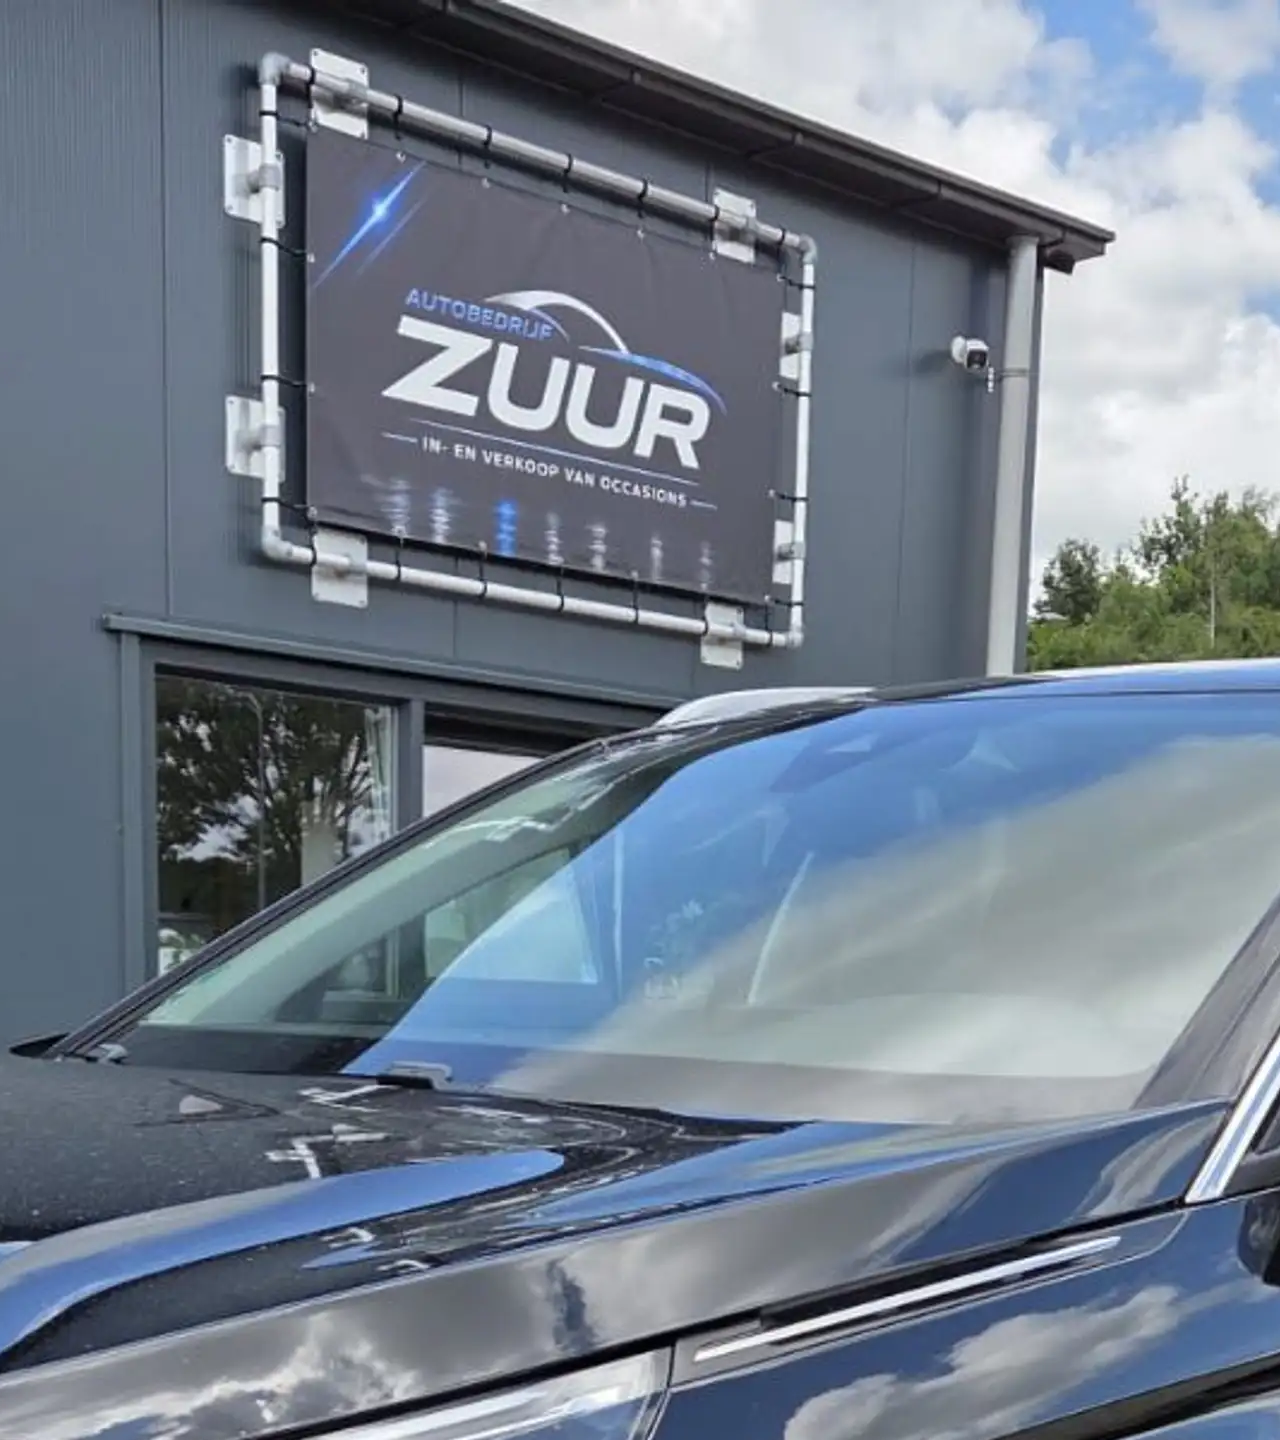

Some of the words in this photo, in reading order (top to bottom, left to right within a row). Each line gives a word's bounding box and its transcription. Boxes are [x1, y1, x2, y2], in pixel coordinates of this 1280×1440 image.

[405, 286, 556, 341] AUTOBEDRIJF
[381, 313, 711, 470] ZUUR
[422, 434, 449, 454] IN-
[454, 442, 476, 461] EN
[482, 450, 560, 478] VERKOOP
[563, 466, 595, 488] VAN
[600, 475, 687, 508] OCCASIONS
